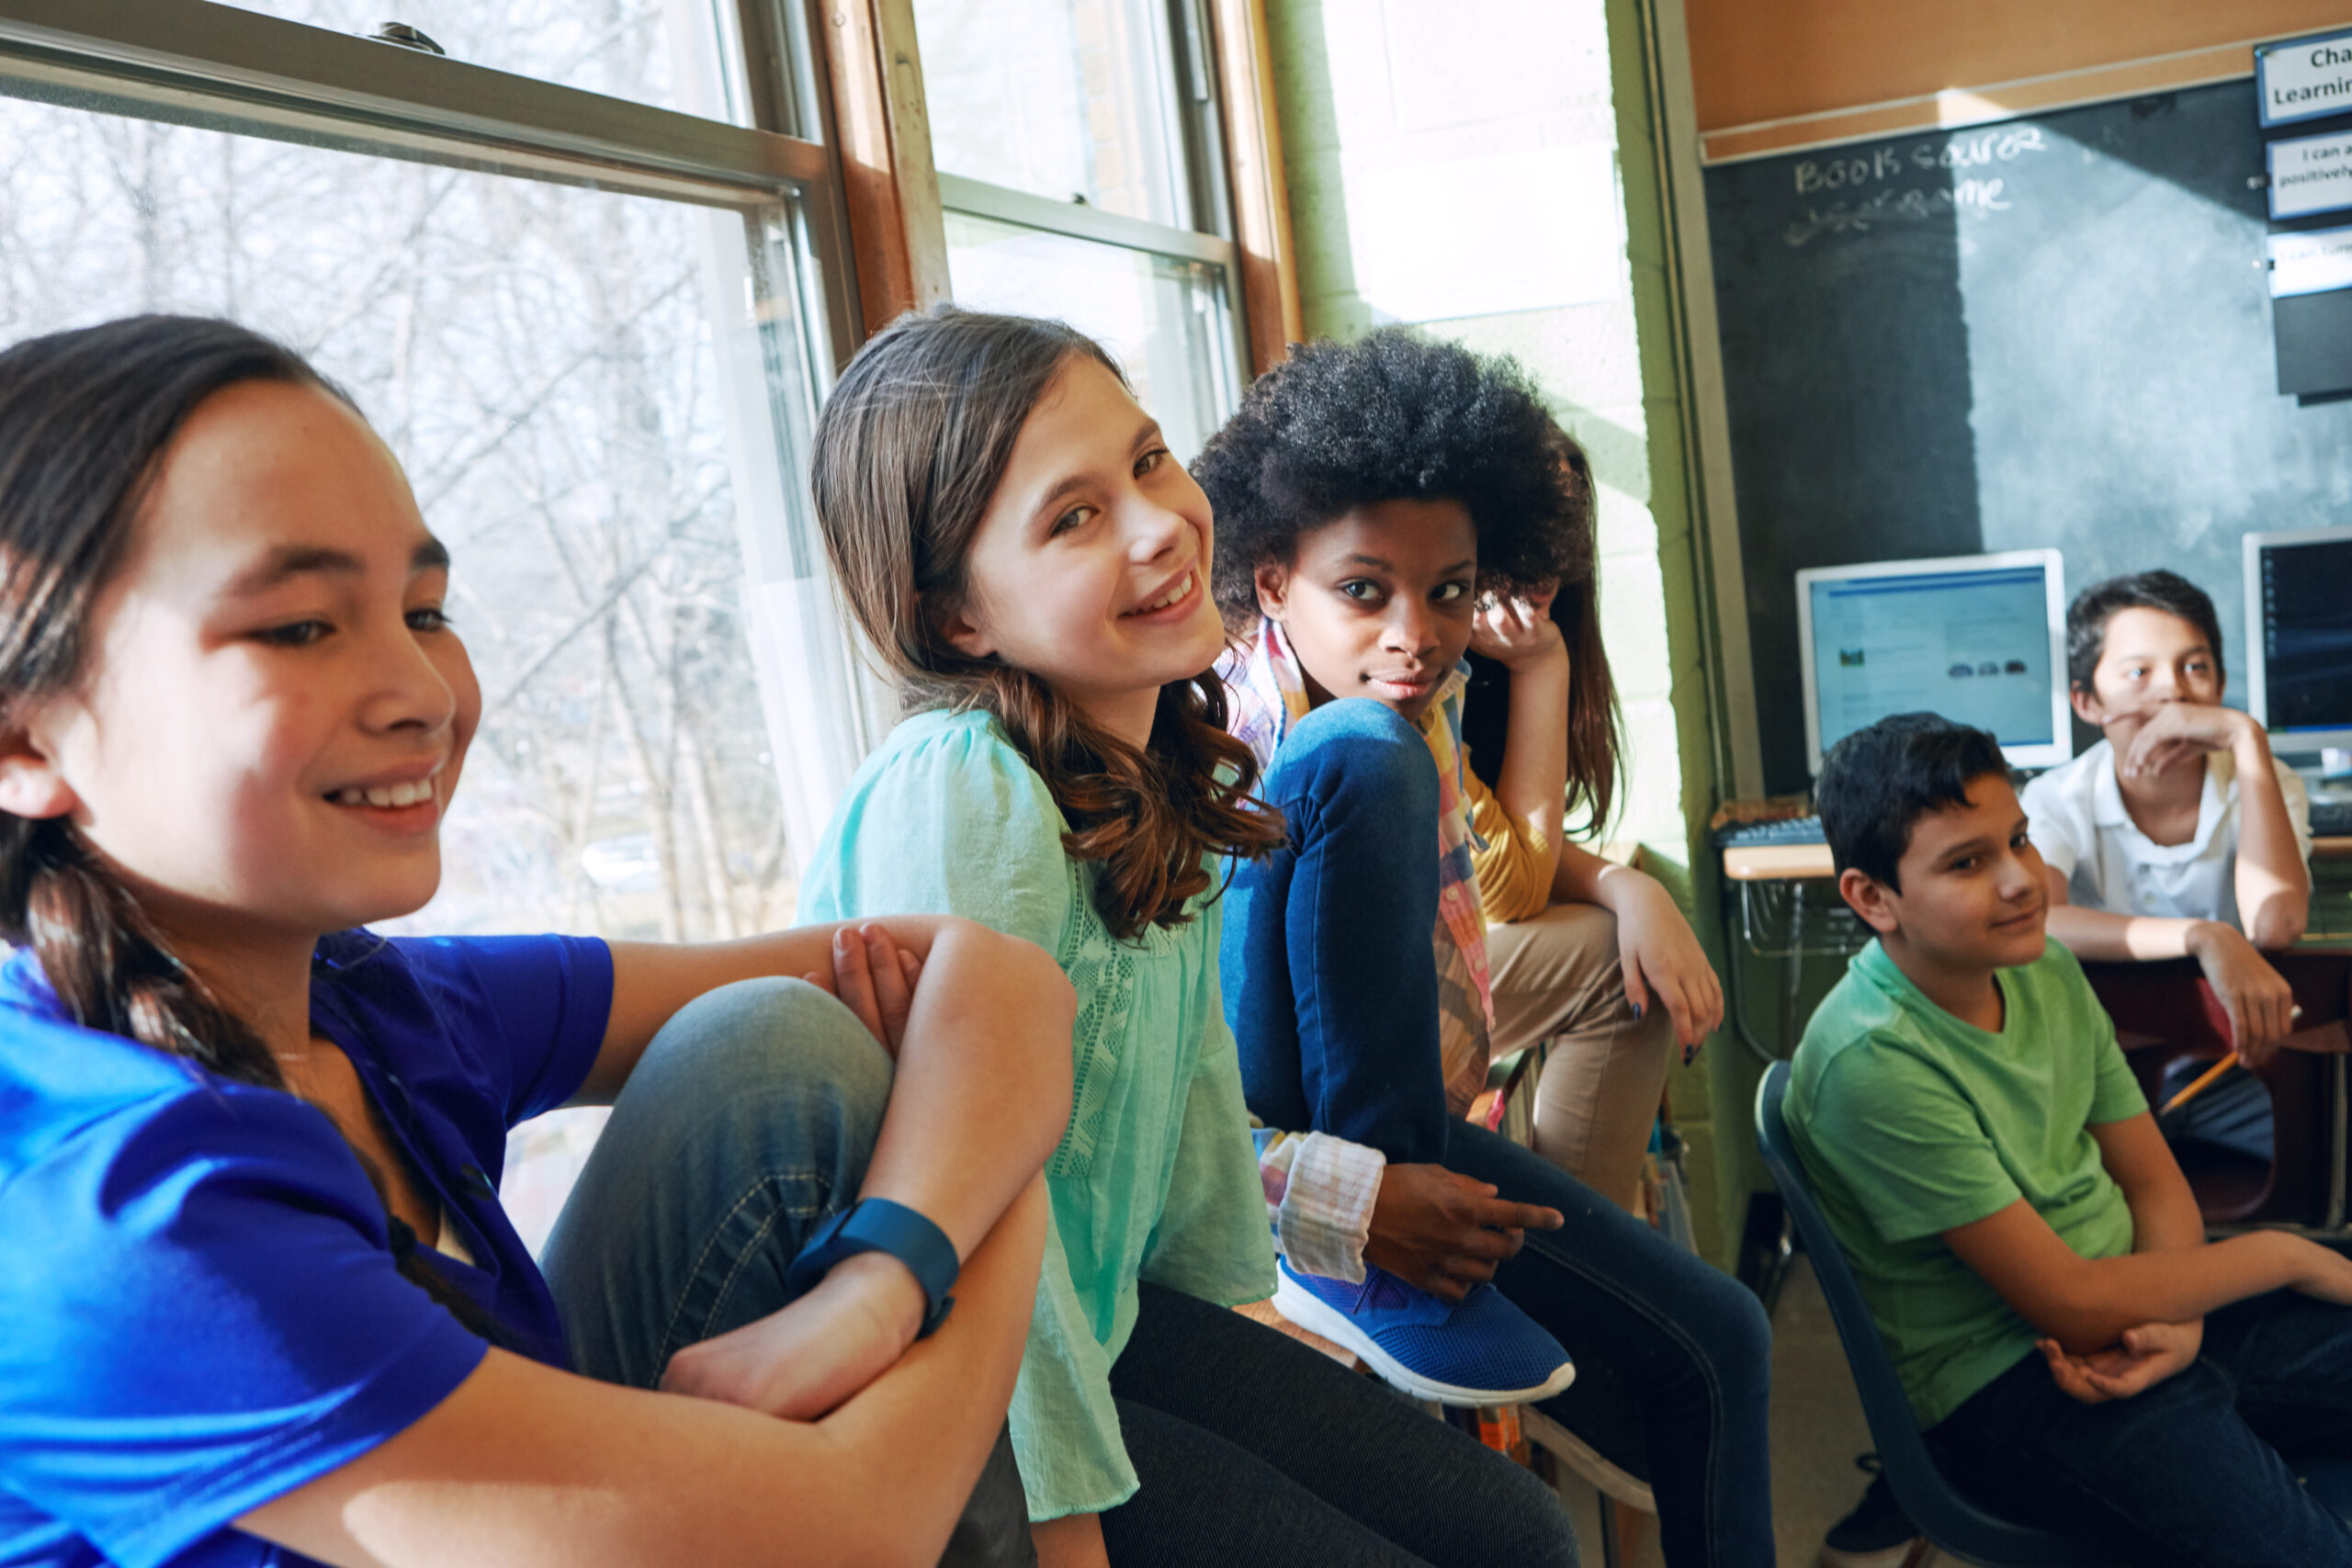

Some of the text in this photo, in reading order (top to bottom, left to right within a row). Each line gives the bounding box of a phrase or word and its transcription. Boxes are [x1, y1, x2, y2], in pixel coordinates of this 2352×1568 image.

[2311, 48, 2352, 68] Cha
[2312, 147, 2340, 161] can
[1794, 147, 1902, 194] Book
